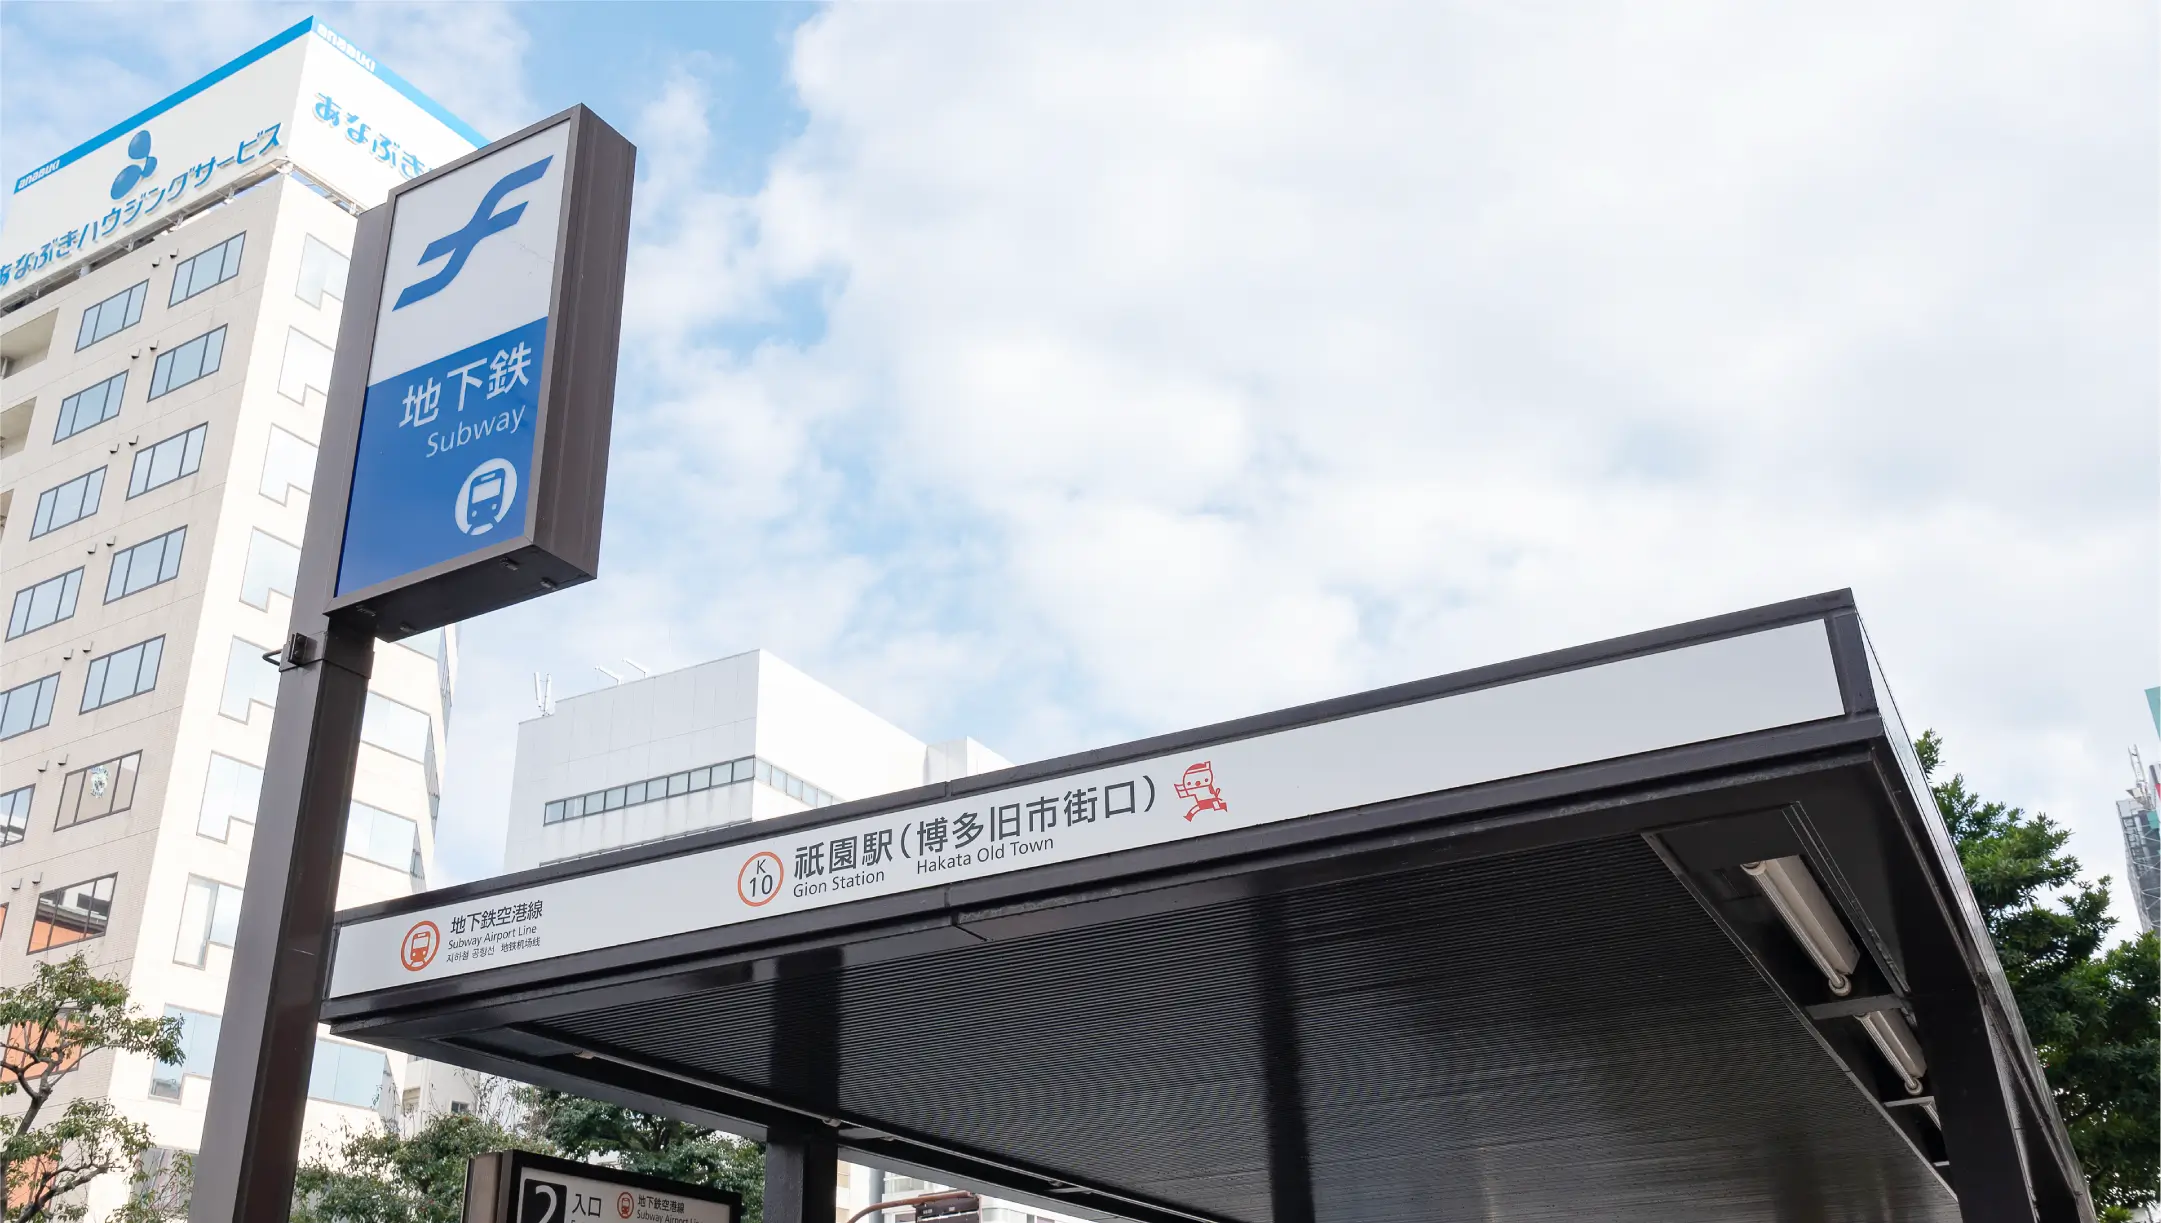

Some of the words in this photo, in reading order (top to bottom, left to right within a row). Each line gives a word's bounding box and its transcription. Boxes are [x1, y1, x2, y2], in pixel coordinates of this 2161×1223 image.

[399, 341, 531, 428] 地下鉄
[426, 405, 526, 458] Subway
[756, 858, 768, 875] K
[917, 852, 972, 875] Hakata
[977, 843, 1005, 863] Old
[1010, 837, 1054, 857] Town
[749, 874, 773, 898] 10
[793, 882, 827, 898] Gion
[832, 870, 885, 891] Station
[450, 900, 543, 934] 地下鉄空港線
[448, 936, 482, 950] Subway
[484, 928, 516, 943] Airport
[519, 925, 537, 937] Line
[501, 936, 541, 952] 地铁机场线
[446, 950, 469, 963] 지하철
[472, 945, 495, 959] 공항선
[535, 1184, 558, 1223] 2
[572, 1193, 602, 1218] 入口
[637, 1209, 664, 1223] Subway
[638, 1194, 685, 1214] 地下鉄空港線
